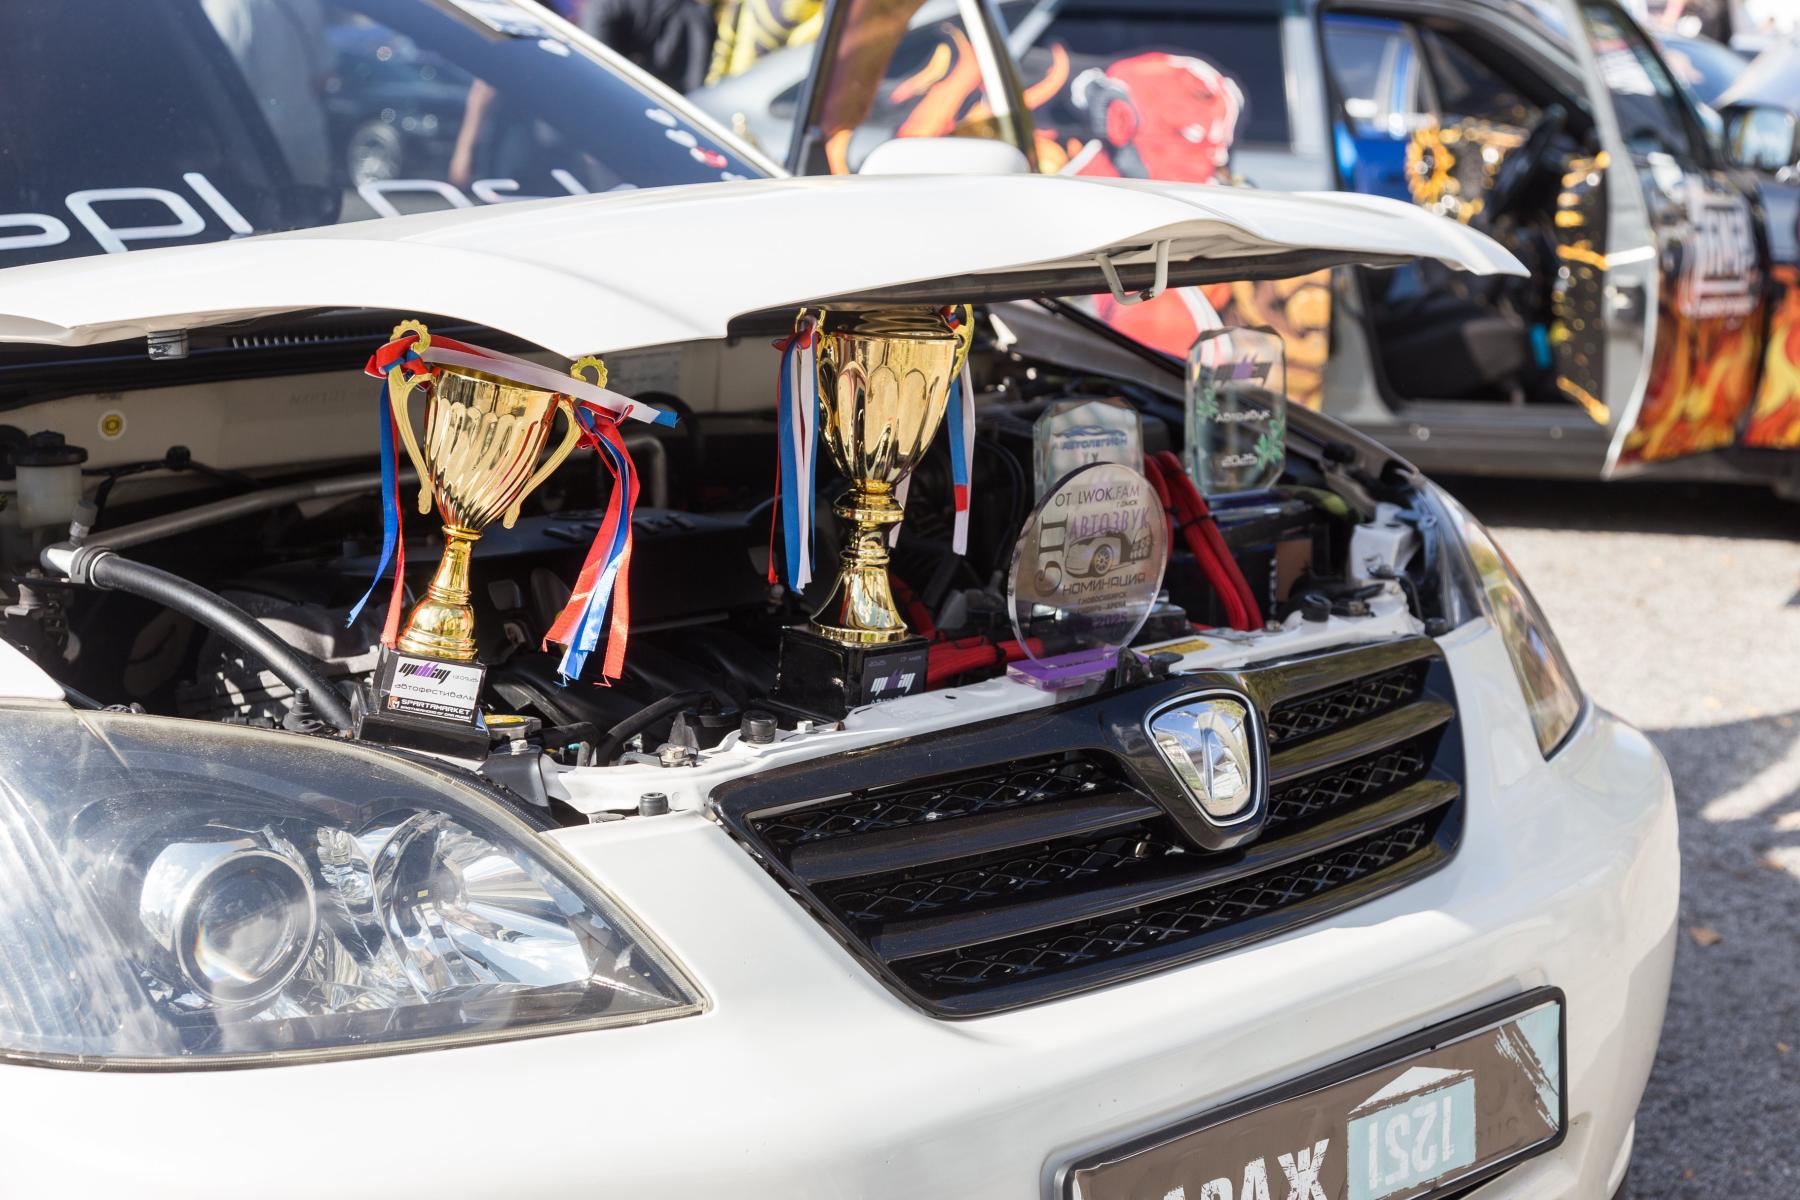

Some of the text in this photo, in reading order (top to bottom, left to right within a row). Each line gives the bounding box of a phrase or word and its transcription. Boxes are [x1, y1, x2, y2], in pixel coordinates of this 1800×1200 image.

[1055, 492, 1072, 507] ОТ
[1069, 506, 1150, 539] АВТОЗВУК
[1062, 573, 1146, 597] НОМИНАЦИЯ
[401, 699, 471, 716] SPARTAMARKET
[1368, 1095, 1455, 1191] 1251
